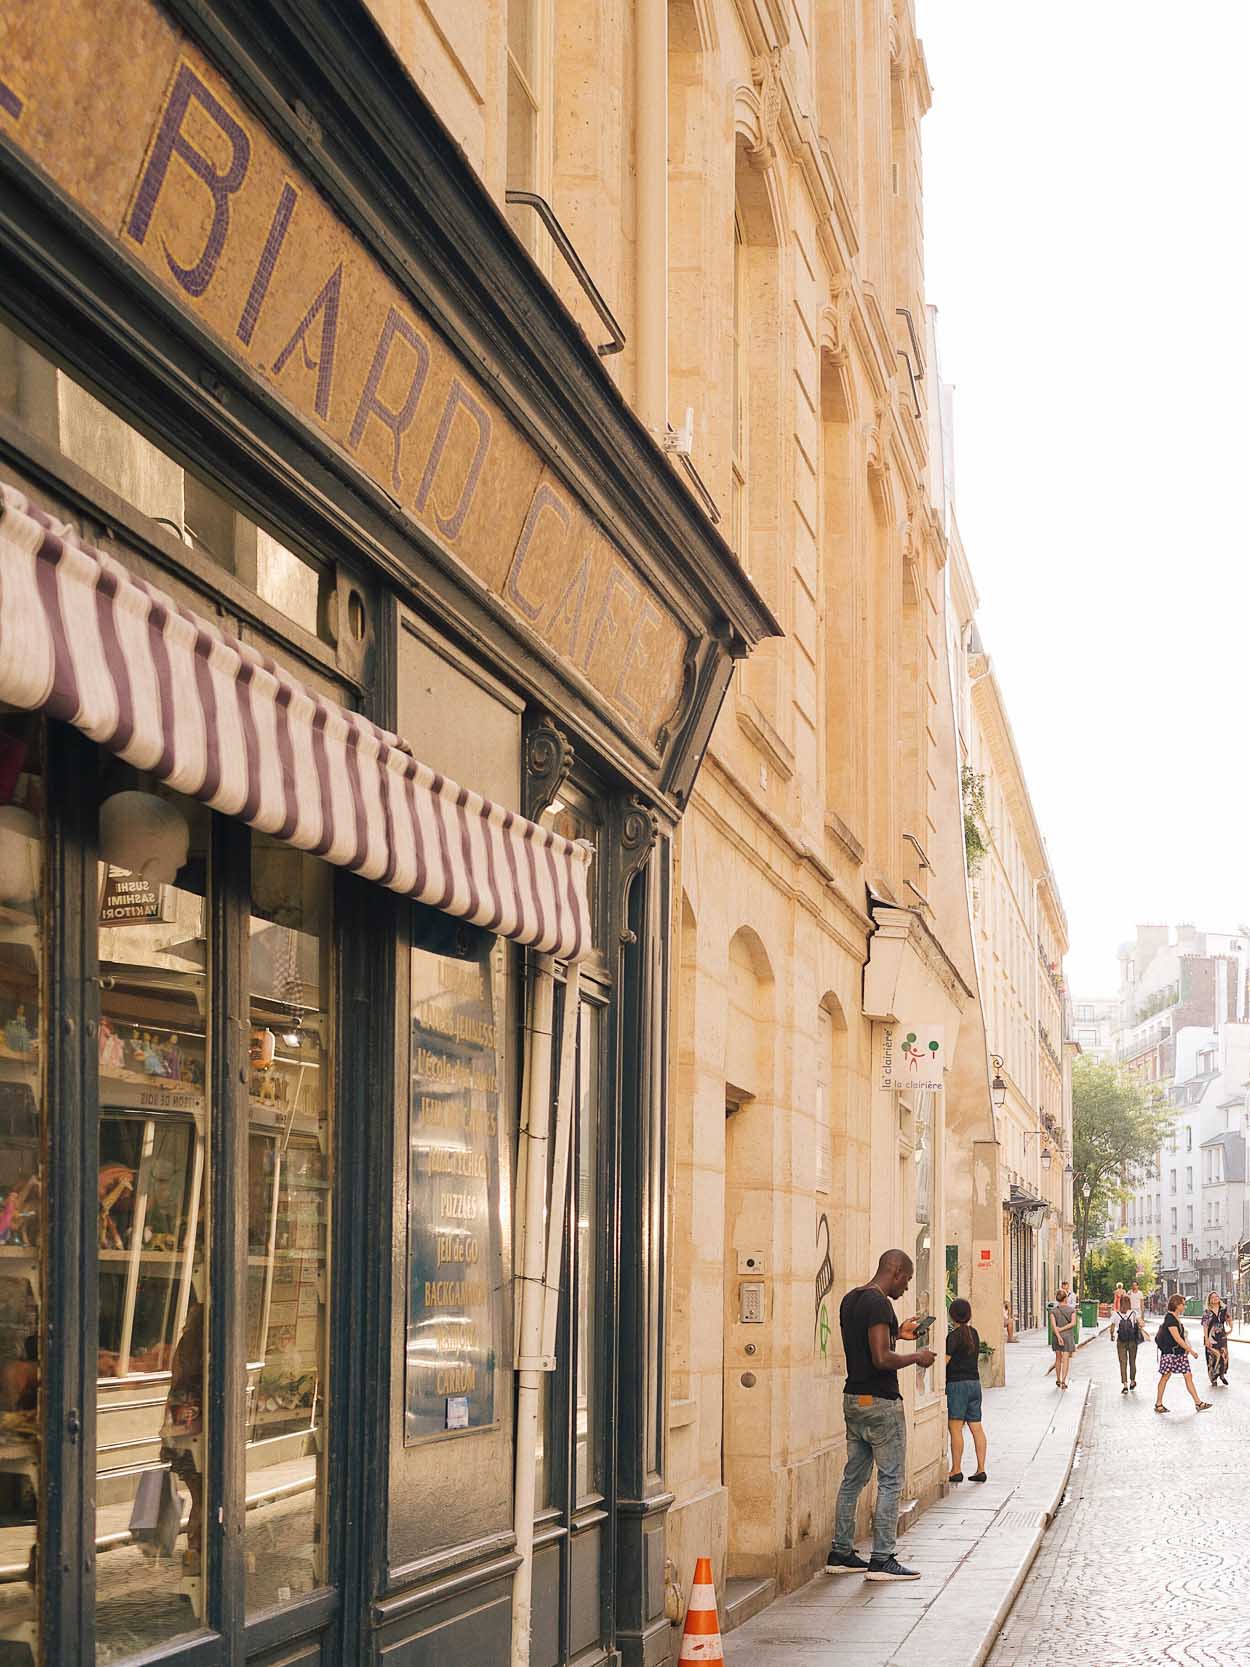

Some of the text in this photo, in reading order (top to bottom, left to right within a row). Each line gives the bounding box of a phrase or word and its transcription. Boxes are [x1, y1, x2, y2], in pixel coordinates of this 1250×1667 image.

[122, 57, 497, 543] BIARD
[437, 1238, 479, 1266] JEU de GO
[436, 1367, 475, 1395] CARROM
